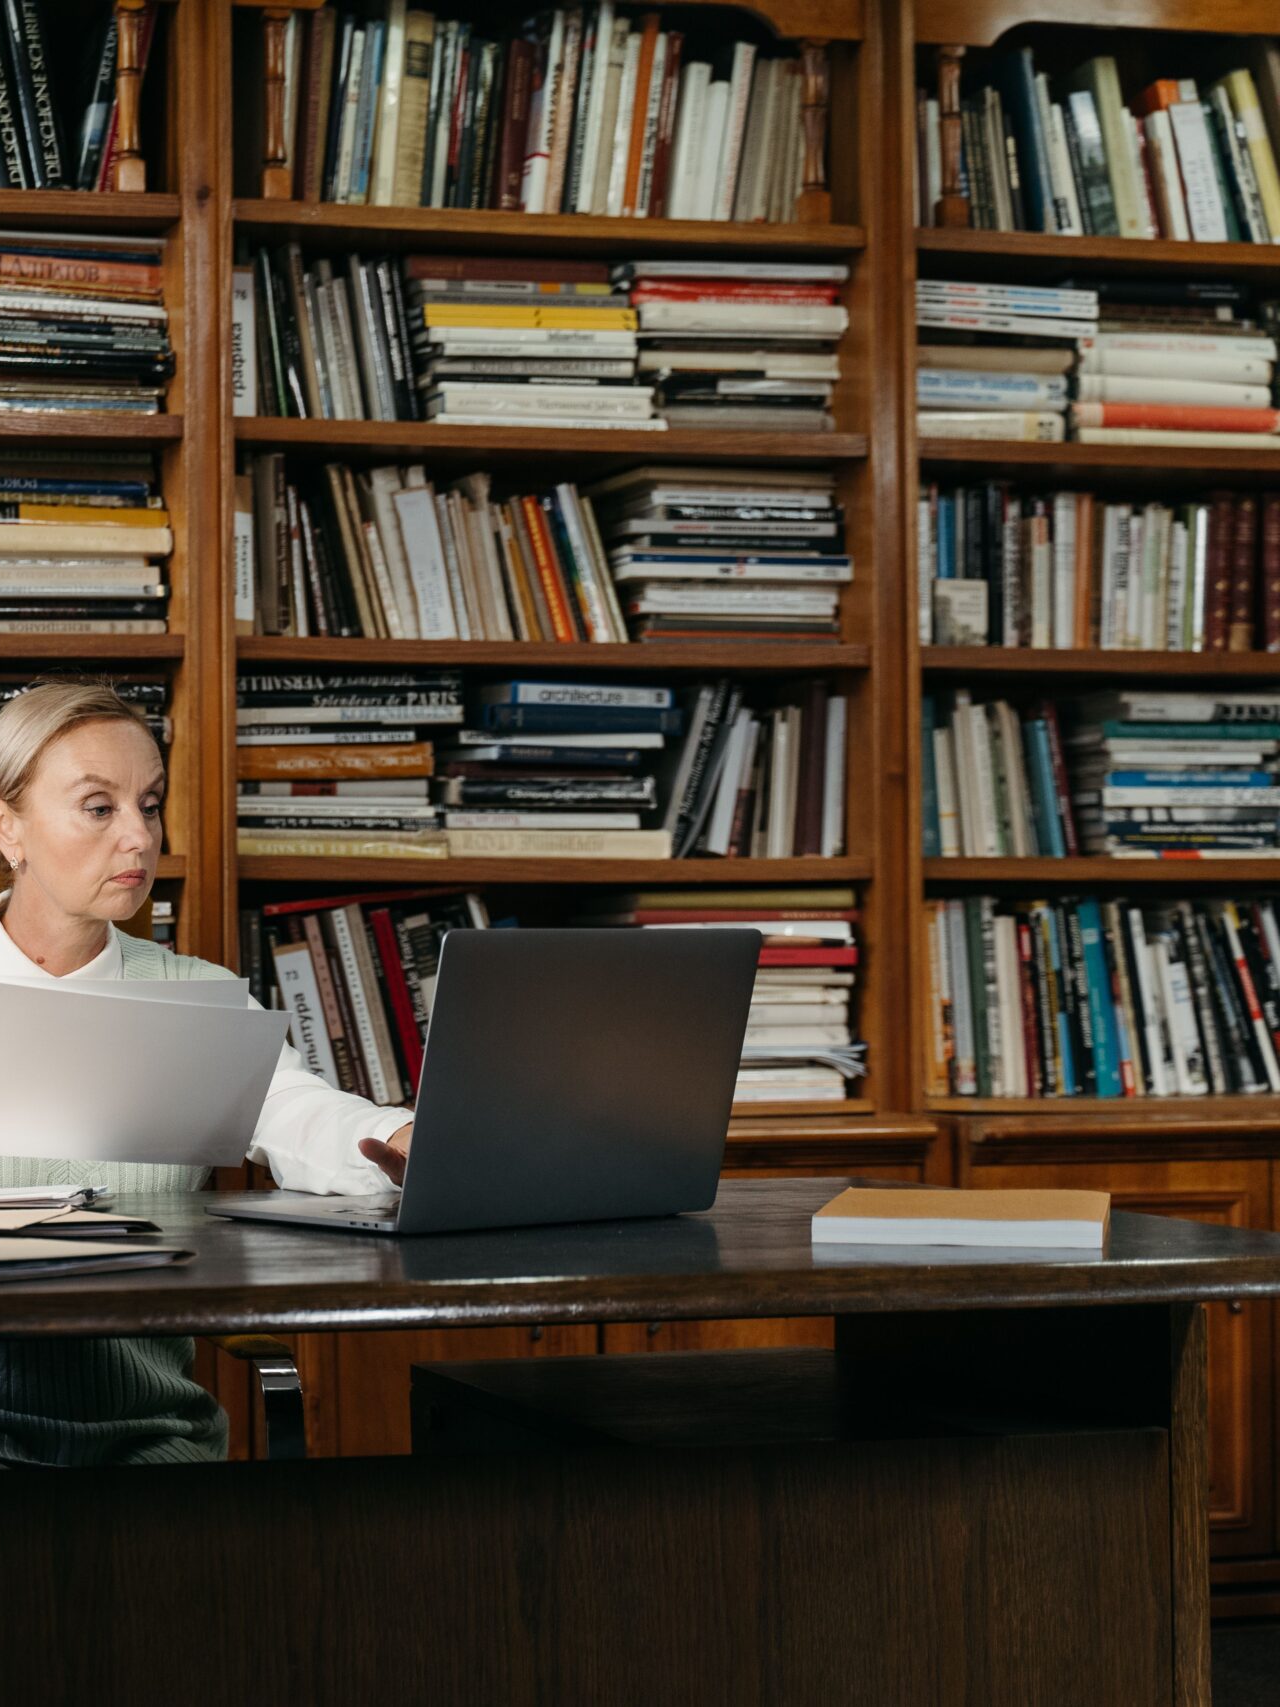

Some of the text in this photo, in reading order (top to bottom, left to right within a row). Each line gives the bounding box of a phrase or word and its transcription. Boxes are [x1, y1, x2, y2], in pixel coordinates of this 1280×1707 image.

[21, 0, 45, 71] SCHRIFT
[5, 155, 22, 183] DIE
[45, 151, 62, 179] DIE
[238, 674, 325, 691] VERSAILLE
[406, 691, 458, 705] PARIS
[395, 922, 414, 970] France
[404, 970, 419, 990] de
[293, 990, 325, 1076] ульптура
